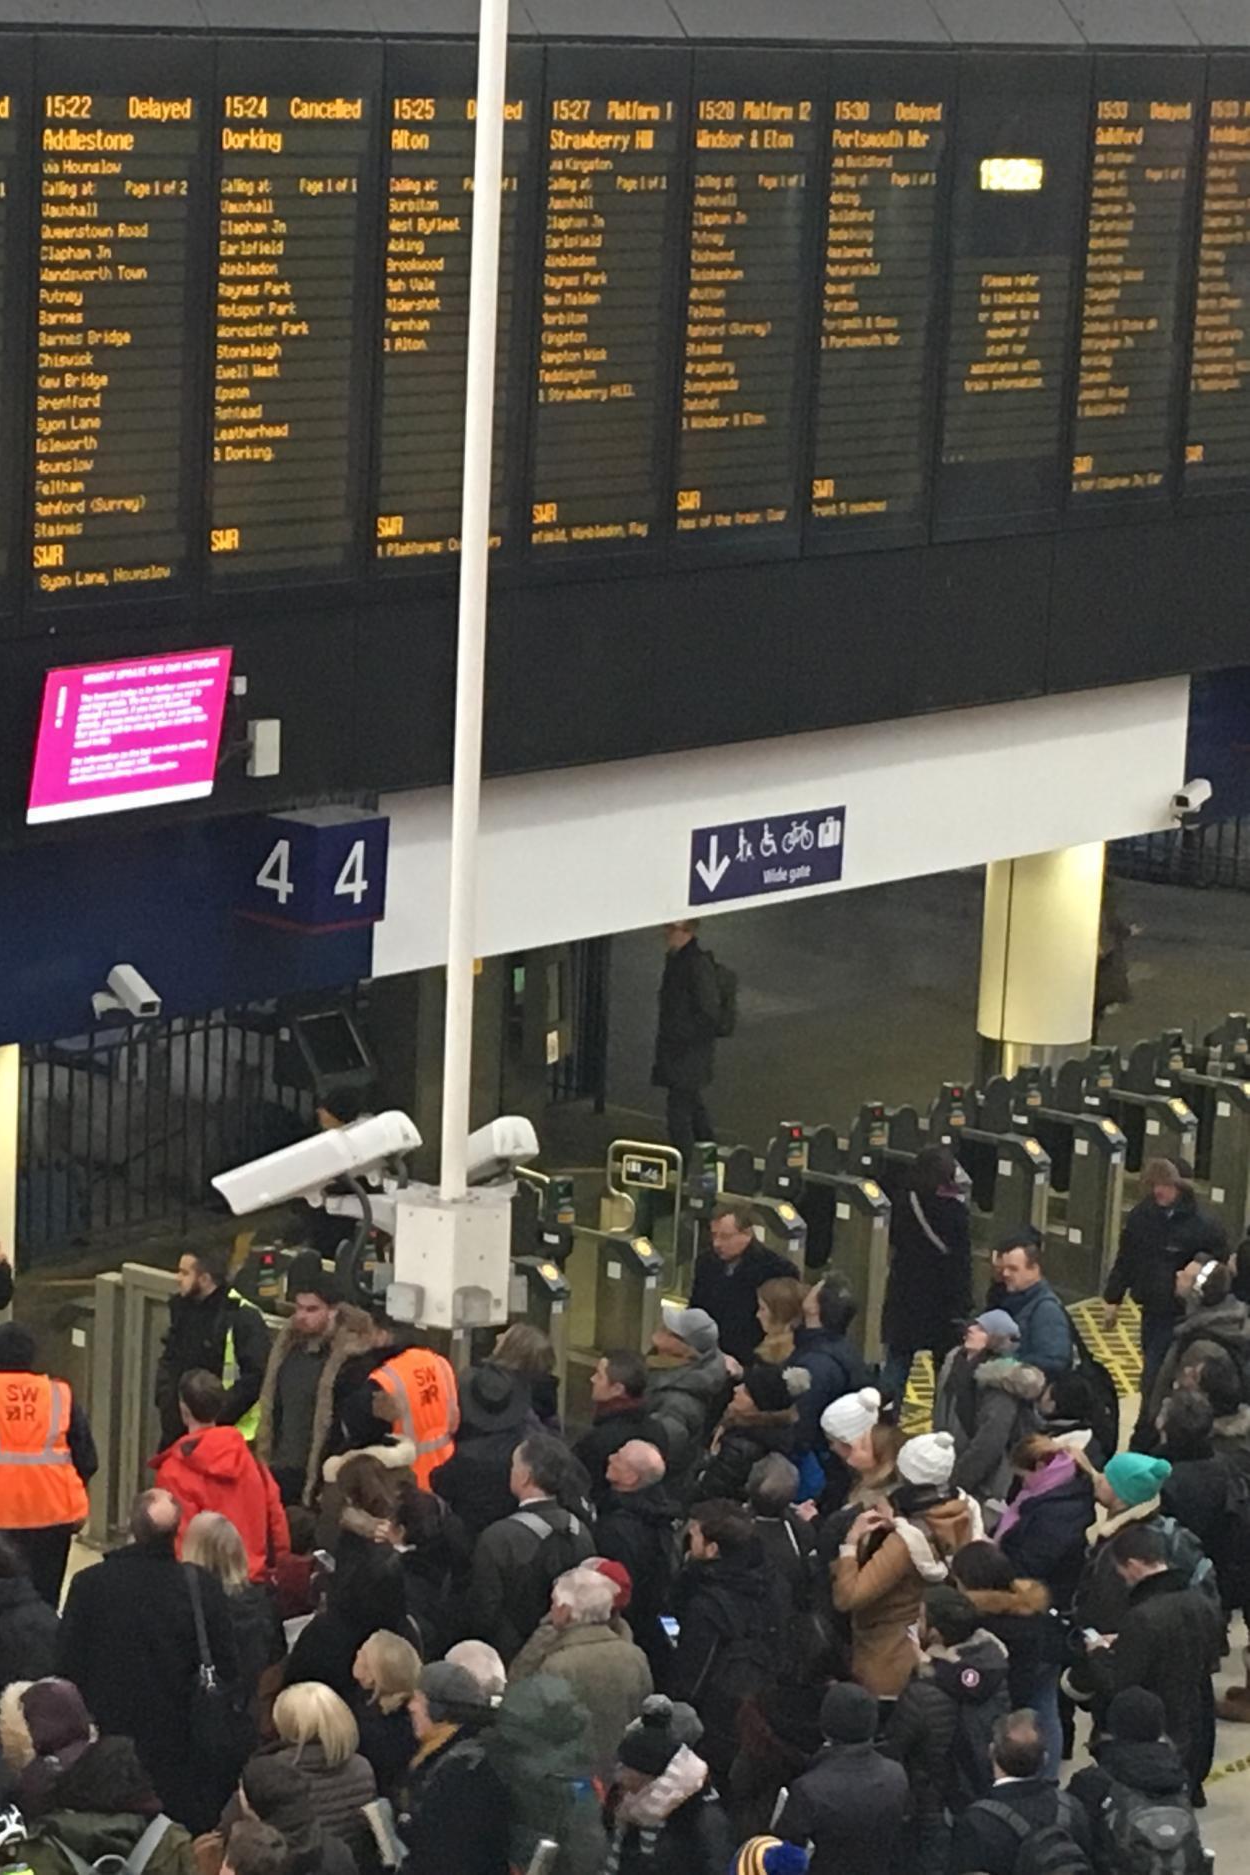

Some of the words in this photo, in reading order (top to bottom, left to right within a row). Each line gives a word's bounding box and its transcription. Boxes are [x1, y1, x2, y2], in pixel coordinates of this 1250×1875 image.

[46, 95, 92, 119] 15:22
[128, 96, 192, 122] Delayed
[225, 96, 268, 118] 15:24
[290, 97, 362, 119] Cancelled
[394, 98, 435, 120] 15:25
[553, 99, 591, 121] 15:27
[43, 128, 134, 151] Addlestone
[222, 128, 282, 153] Dorking
[391, 129, 430, 150] Alton
[550, 129, 631, 152] Strawberry
[211, 528, 239, 552] SWR
[33, 544, 64, 568] SWR
[256, 840, 294, 904] 4
[334, 840, 368, 904] 4
[763, 868, 787, 883] Wide
[790, 865, 811, 883] gate
[6, 1384, 39, 1403] SW
